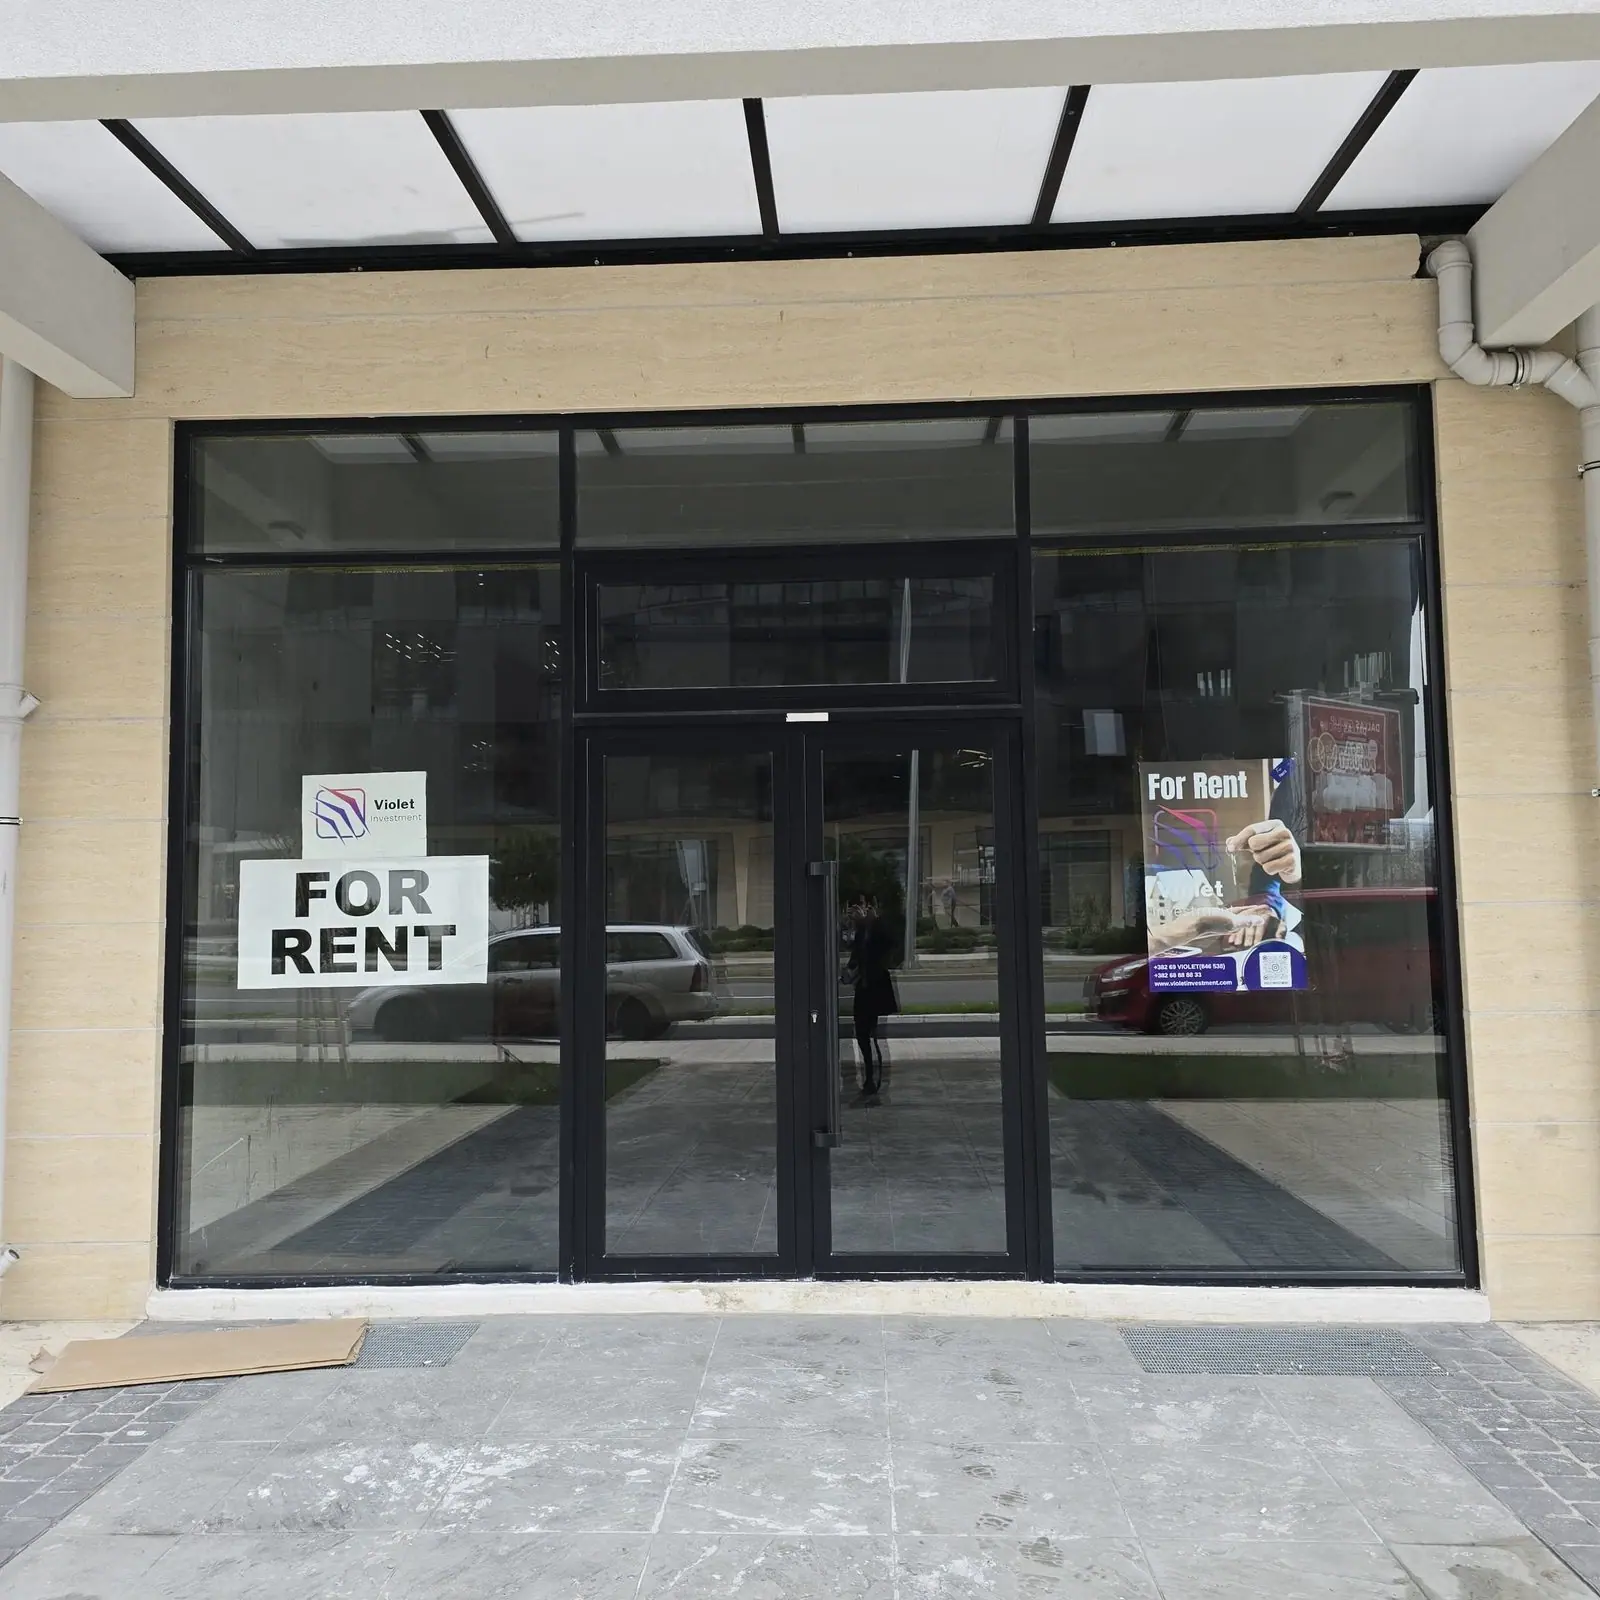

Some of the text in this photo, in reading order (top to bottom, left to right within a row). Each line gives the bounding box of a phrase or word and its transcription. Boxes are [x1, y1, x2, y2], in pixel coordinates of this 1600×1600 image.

[1148, 771, 1248, 801] For Rent
[374, 798, 415, 810] Violet
[370, 813, 422, 823] Investment
[294, 869, 433, 917] FOR
[271, 924, 457, 975] RENT
[1153, 980, 1233, 988] www.violetinvestment.com
